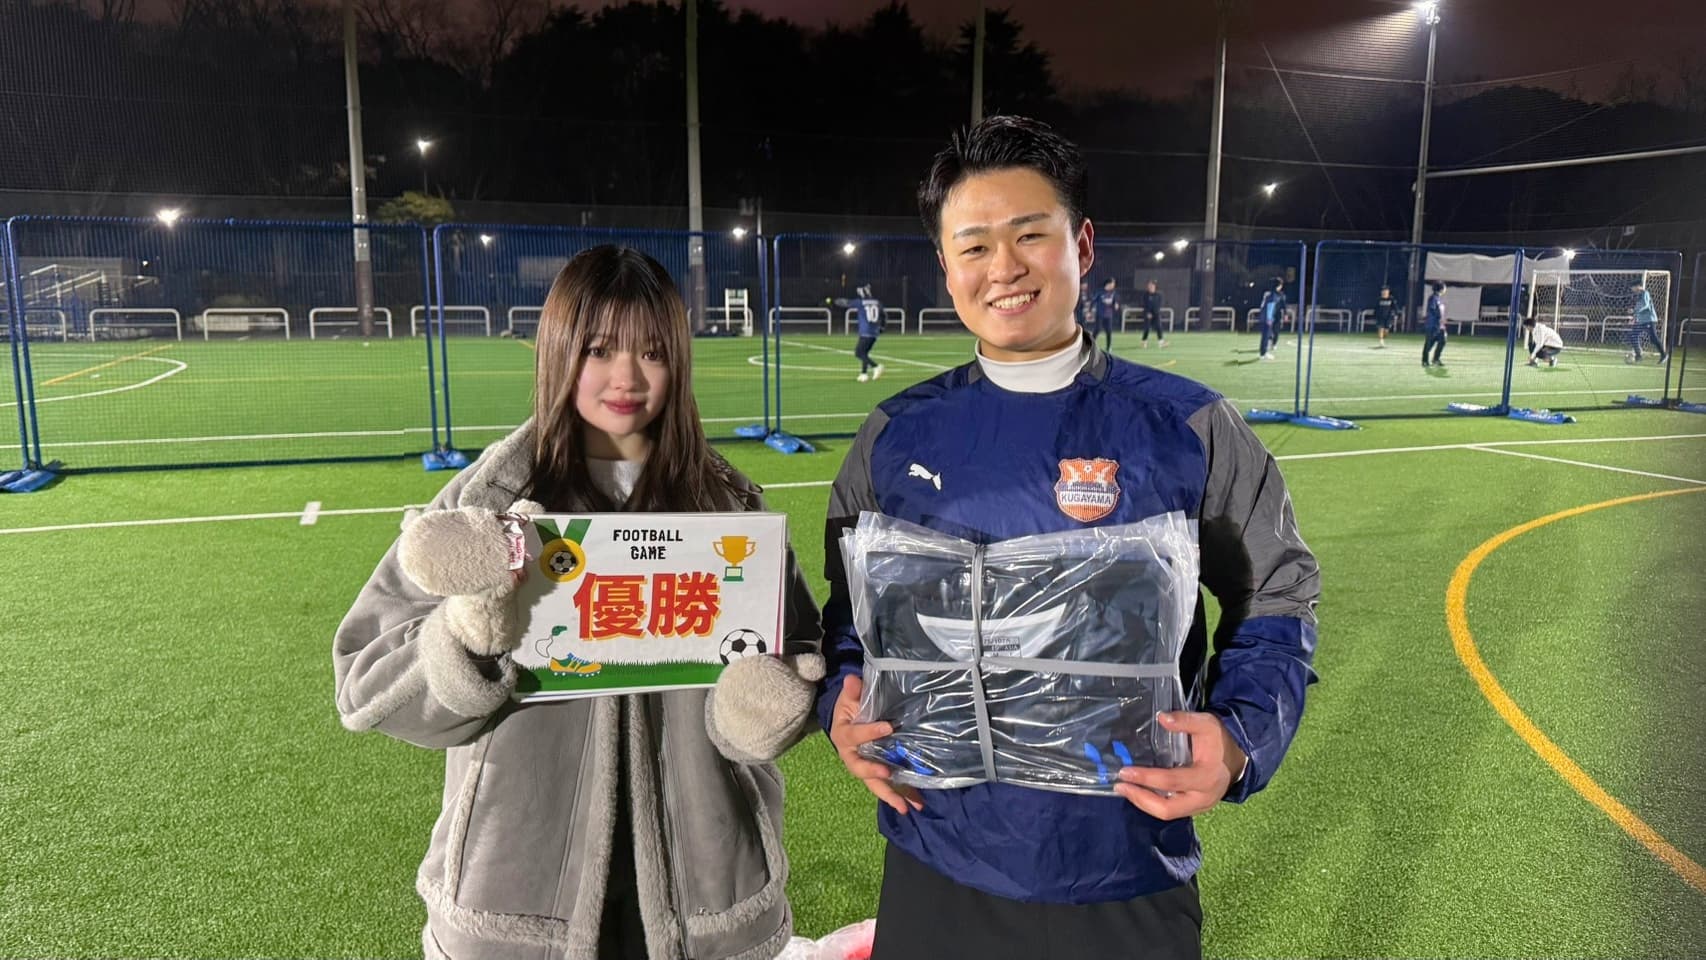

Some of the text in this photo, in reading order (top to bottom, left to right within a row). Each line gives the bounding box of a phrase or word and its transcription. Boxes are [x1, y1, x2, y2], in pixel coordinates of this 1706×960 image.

[865, 305, 879, 322] 10
[1061, 493, 1111, 505] KUGAYAMA
[613, 529, 683, 542] FOOTBALL
[630, 546, 666, 560] GAME
[573, 571, 721, 641] 優勝
